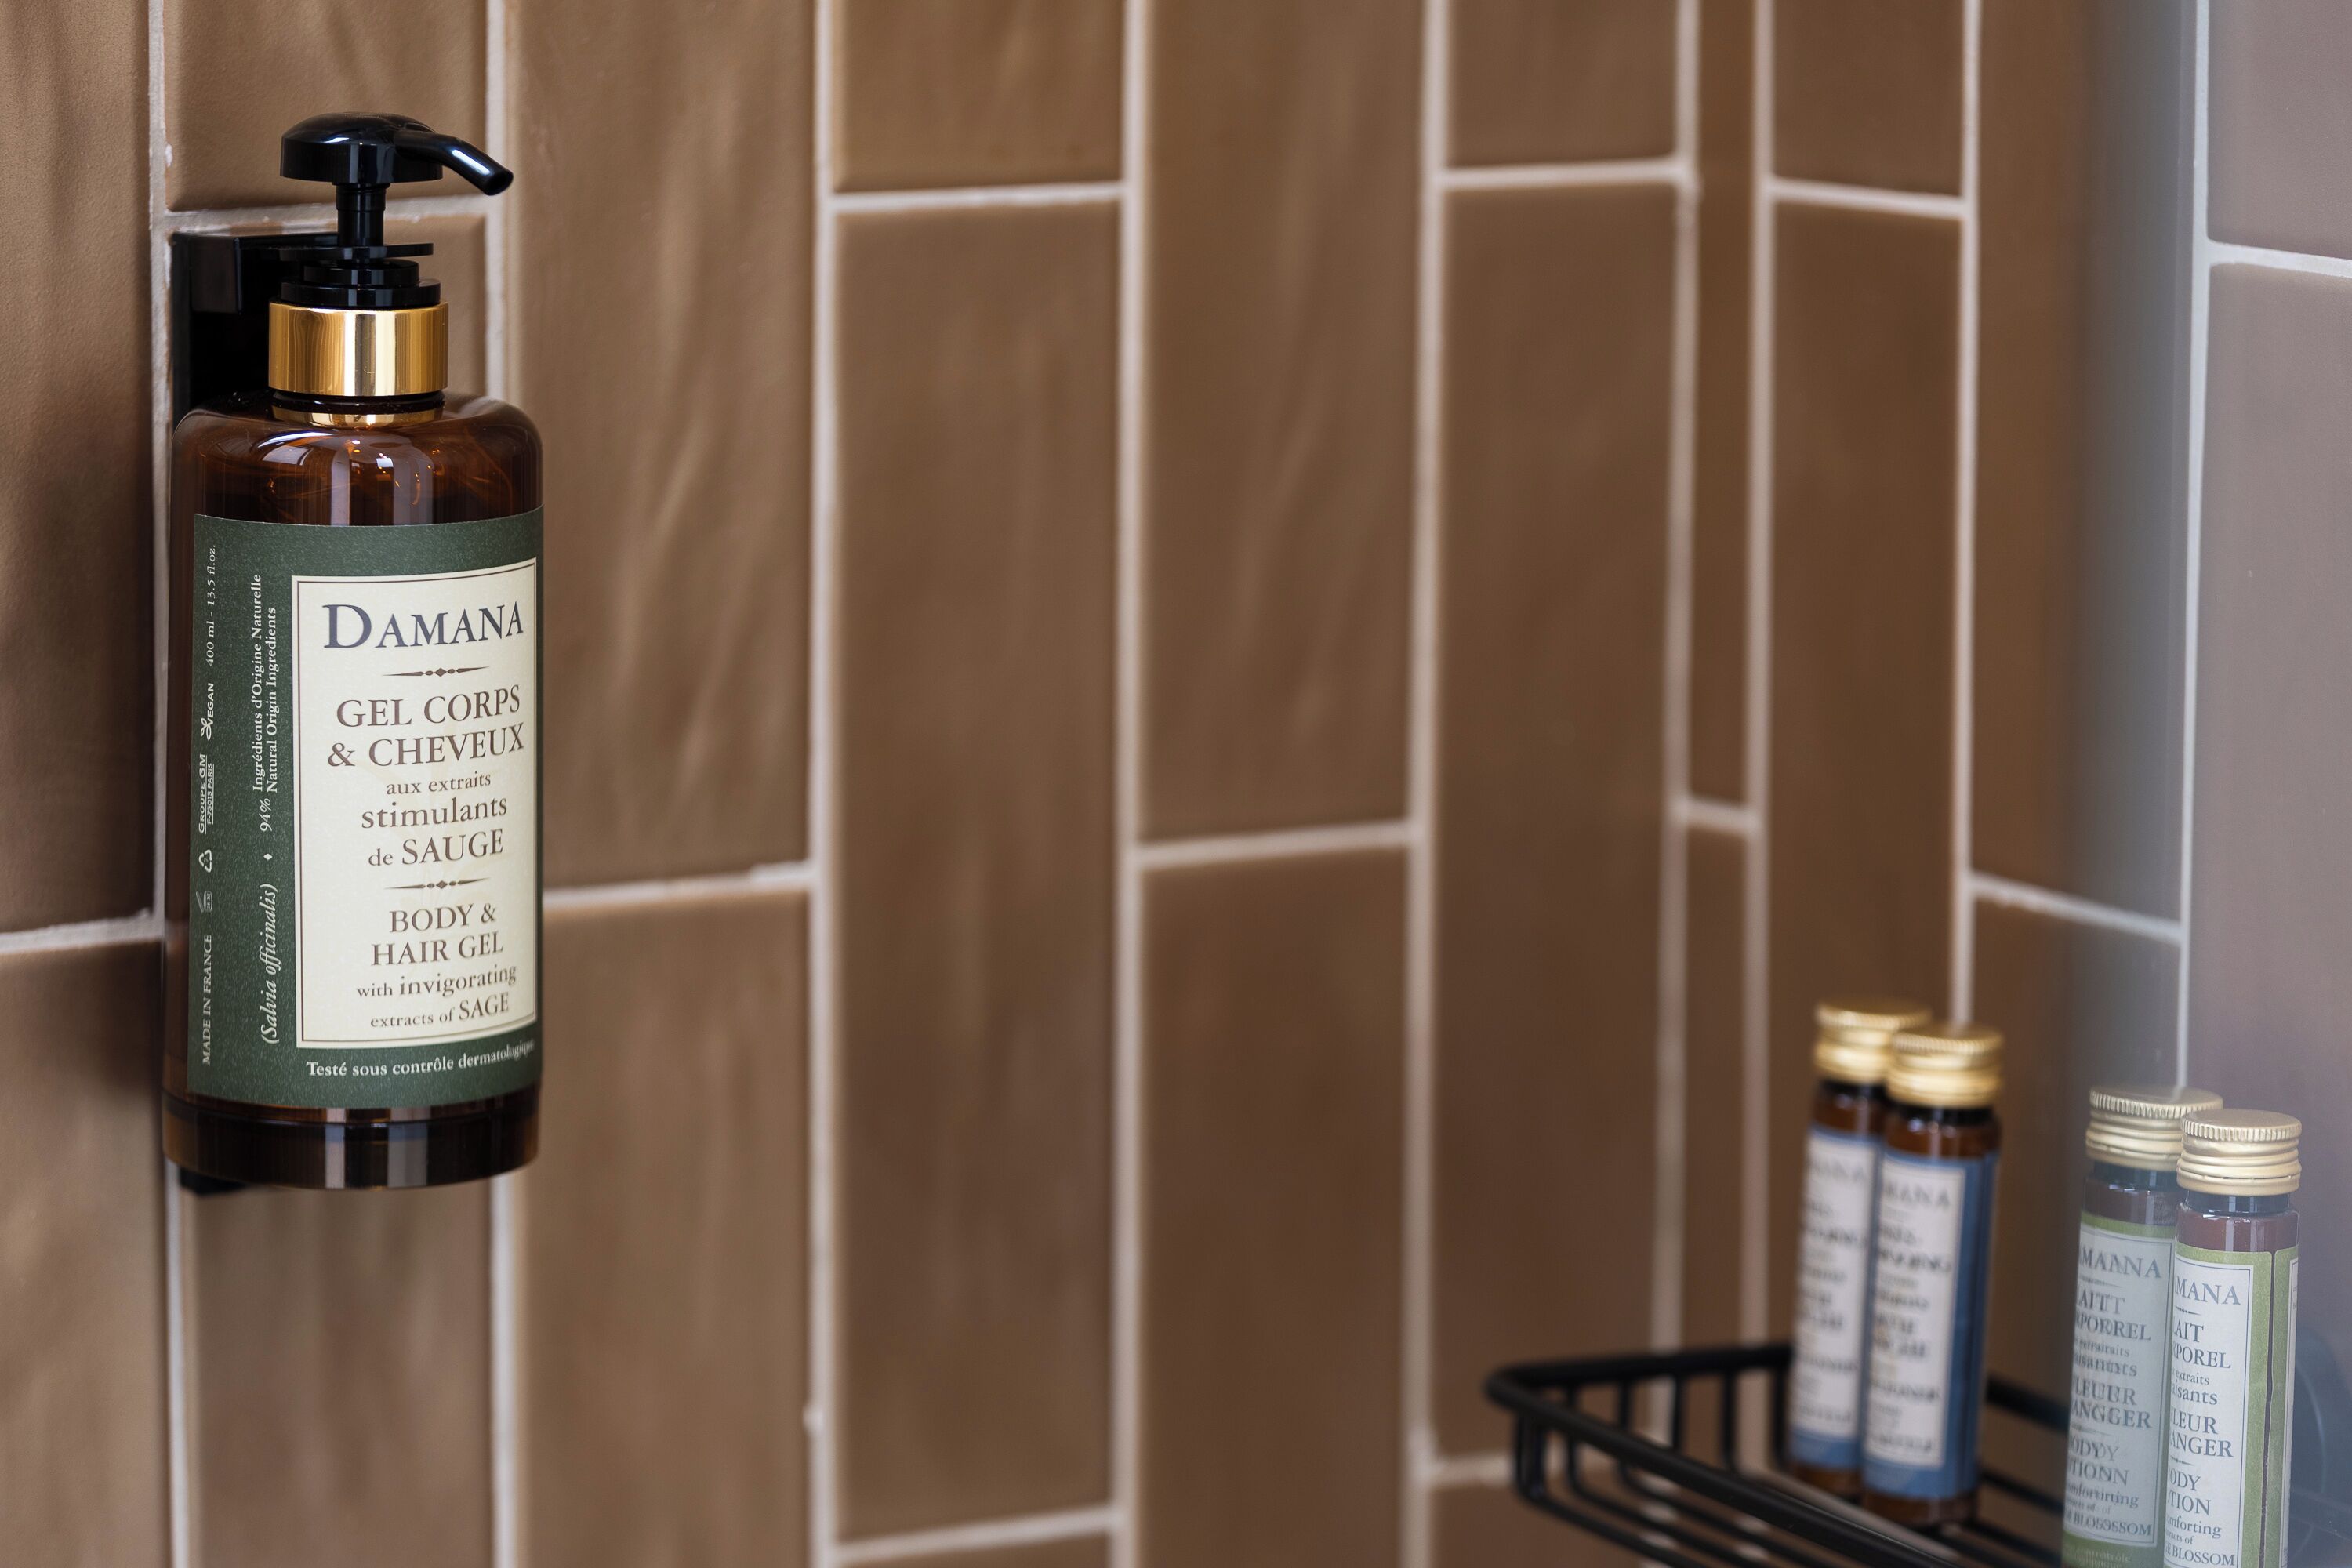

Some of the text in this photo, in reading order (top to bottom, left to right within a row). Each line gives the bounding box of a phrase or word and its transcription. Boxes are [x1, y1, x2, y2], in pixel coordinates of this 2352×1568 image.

[206, 578, 216, 605] 13.5
[251, 574, 262, 638] Naturelle
[205, 619, 216, 639] ml
[322, 601, 524, 648] DAMANA
[205, 641, 216, 667] 400
[206, 682, 215, 726] VEGAN
[266, 607, 279, 793] Natural Origin Ingredients
[336, 684, 520, 728] GEL CORPS
[252, 712, 265, 792] Ingrédients
[328, 722, 524, 767] & CHEVEUX
[199, 754, 205, 779] GM
[386, 771, 491, 795] aux extraits
[259, 798, 272, 832] 94%
[361, 797, 506, 829] stimulants
[368, 829, 503, 866] de SAUGE
[389, 903, 496, 933] BODY &
[259, 884, 281, 1044] (Salvia officinalis)
[371, 931, 503, 966] HAIR GEL
[357, 964, 517, 997] with invigorating
[202, 934, 212, 1066] MADE IN FRANCE
[371, 992, 509, 1028] extracts of SAGE
[306, 1061, 347, 1076] Testé
[352, 1064, 387, 1076] sous
[392, 1056, 454, 1076] contrôle
[2175, 1276, 2241, 1305] MANA
[2174, 1319, 2204, 1343] AIT
[2176, 1370, 2209, 1385] extraits
[2172, 1406, 2219, 1435] LEUR
[2169, 1468, 2201, 1491] ODY
[2168, 1490, 2211, 1515] TION
[2172, 1544, 2236, 1566] BLOSSOM
[2185, 1536, 2194, 1544] of
